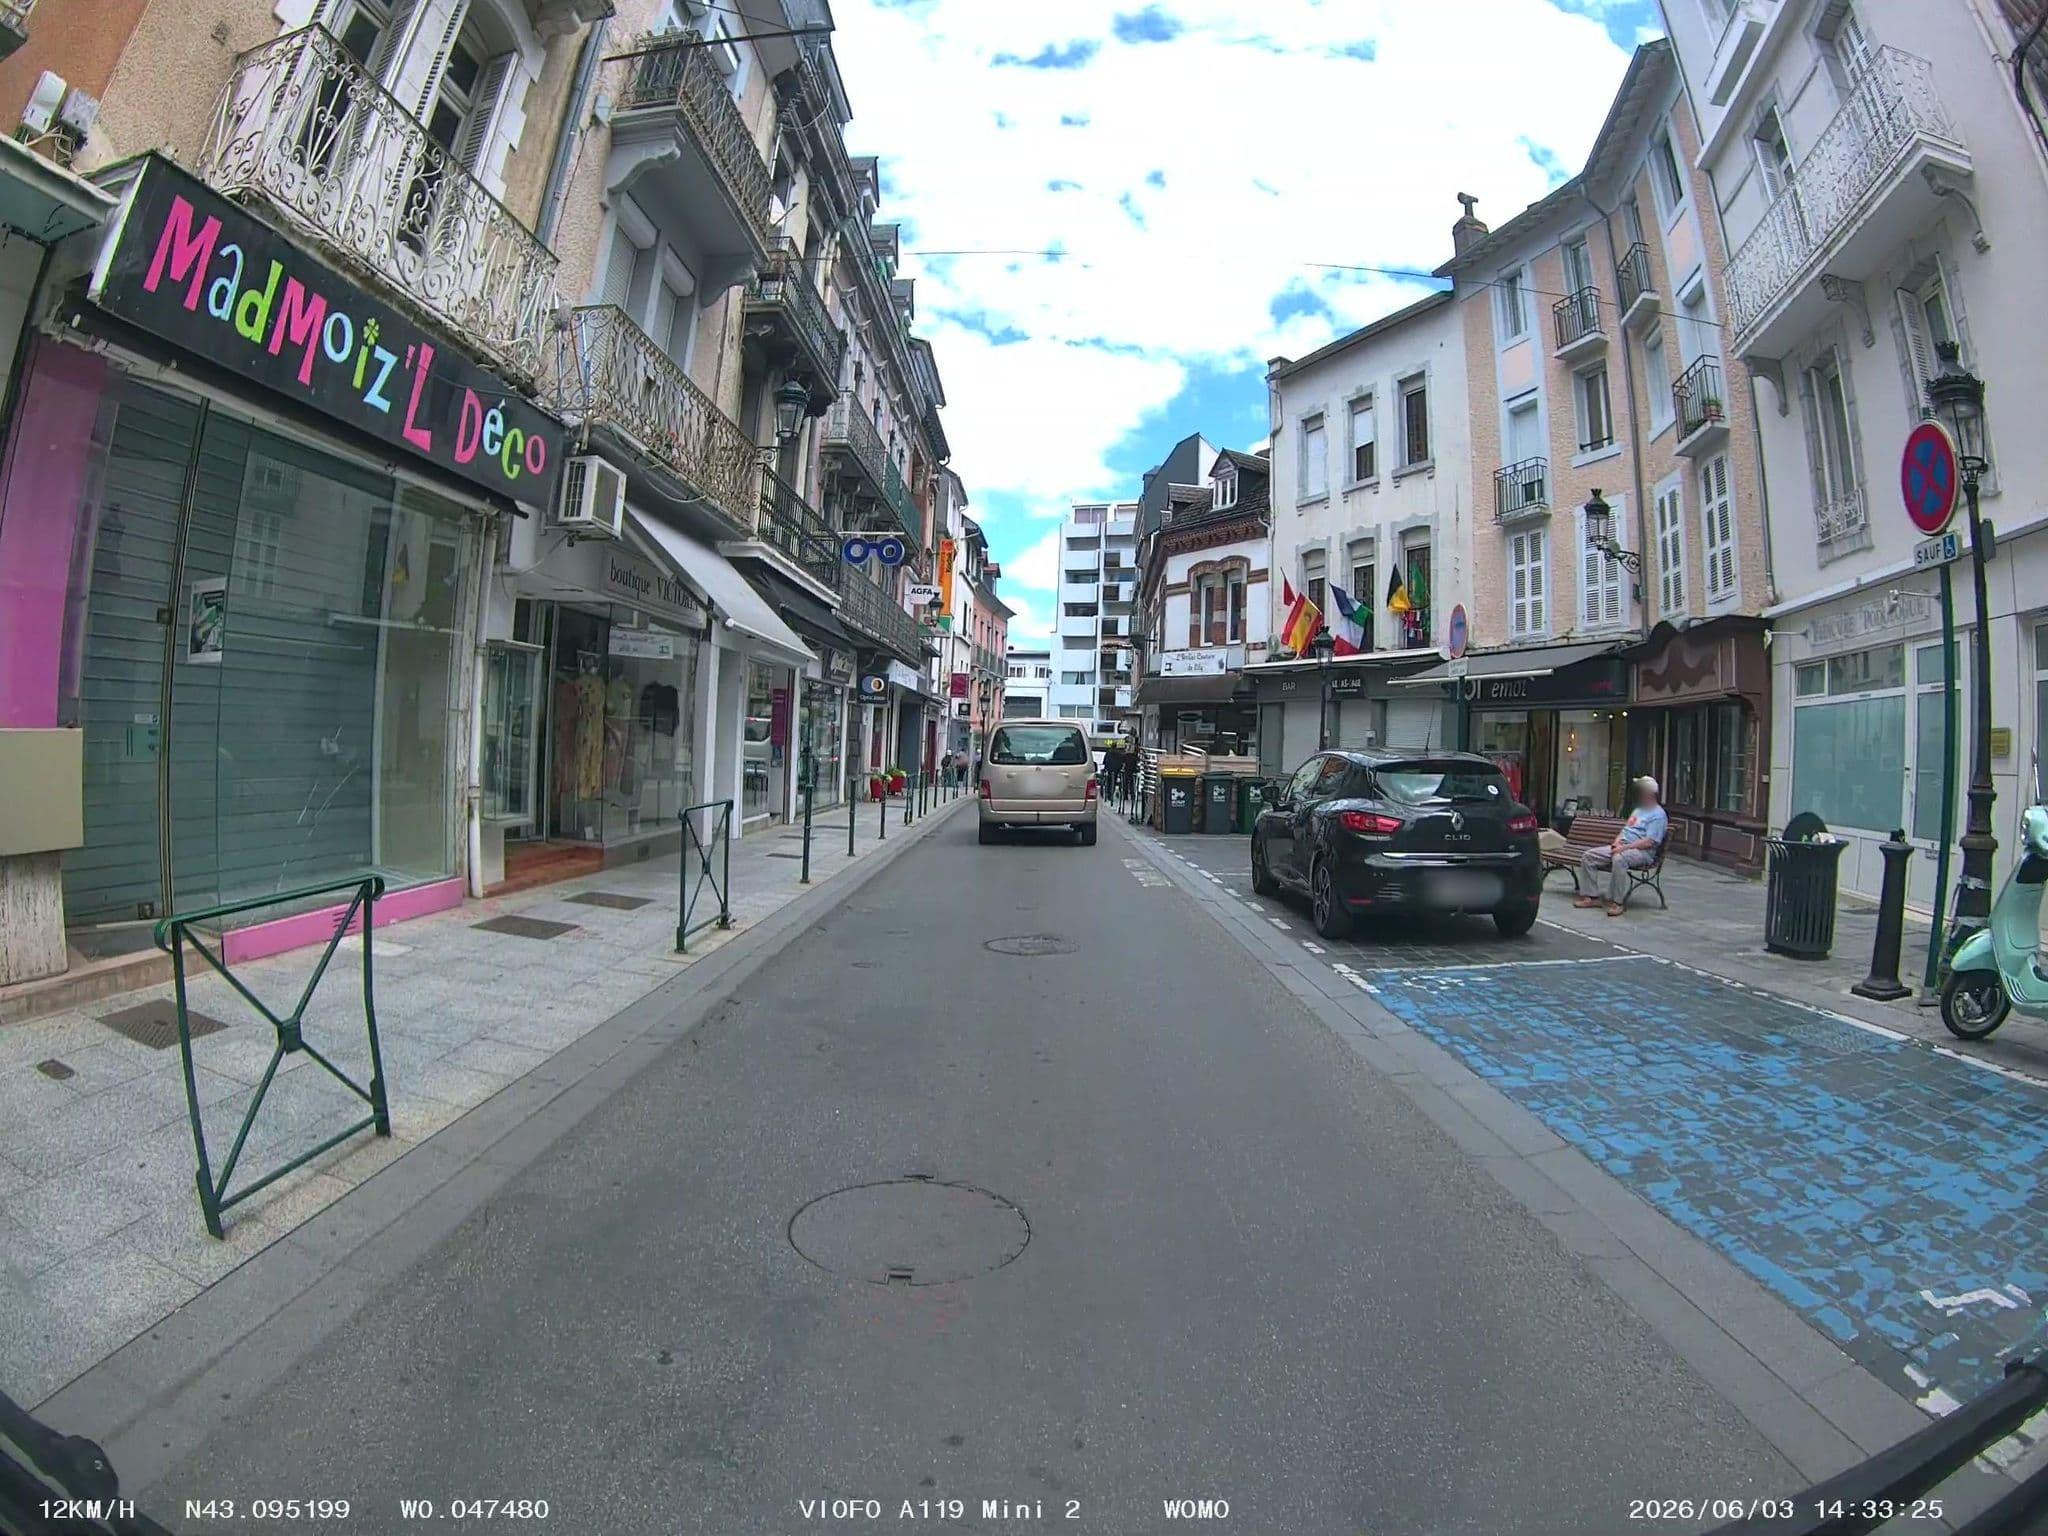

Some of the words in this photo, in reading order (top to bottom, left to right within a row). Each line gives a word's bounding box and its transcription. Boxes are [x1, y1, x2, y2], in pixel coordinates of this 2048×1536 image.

[143, 195, 434, 452] MadMoiz'L
[455, 388, 547, 481] Déco
[1916, 543, 1941, 566] SAUF
[609, 557, 650, 601] boutique
[911, 587, 933, 596] AGFA
[1282, 681, 1297, 692] BAR
